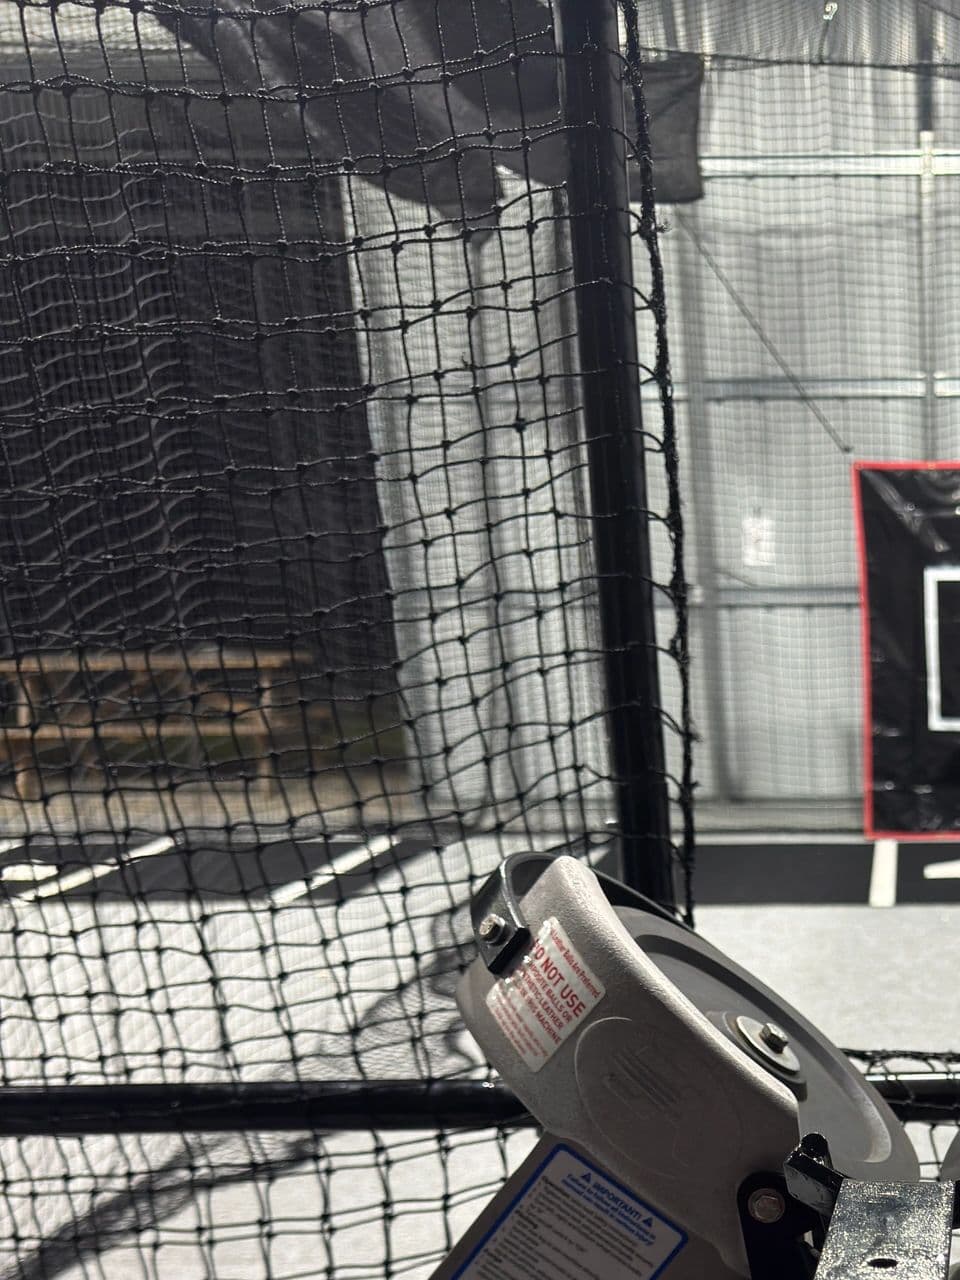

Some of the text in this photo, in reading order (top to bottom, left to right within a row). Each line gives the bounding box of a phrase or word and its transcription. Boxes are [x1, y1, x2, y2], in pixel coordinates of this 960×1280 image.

[539, 955, 565, 990] NOT
[558, 982, 587, 1018] USE
[545, 986, 565, 1013] BALLS
[560, 1008, 572, 1024] OR
[534, 1008, 561, 1046] MACHINE
[538, 995, 564, 1031] LEATHER
[590, 1180, 643, 1220] IMPORTANT!
